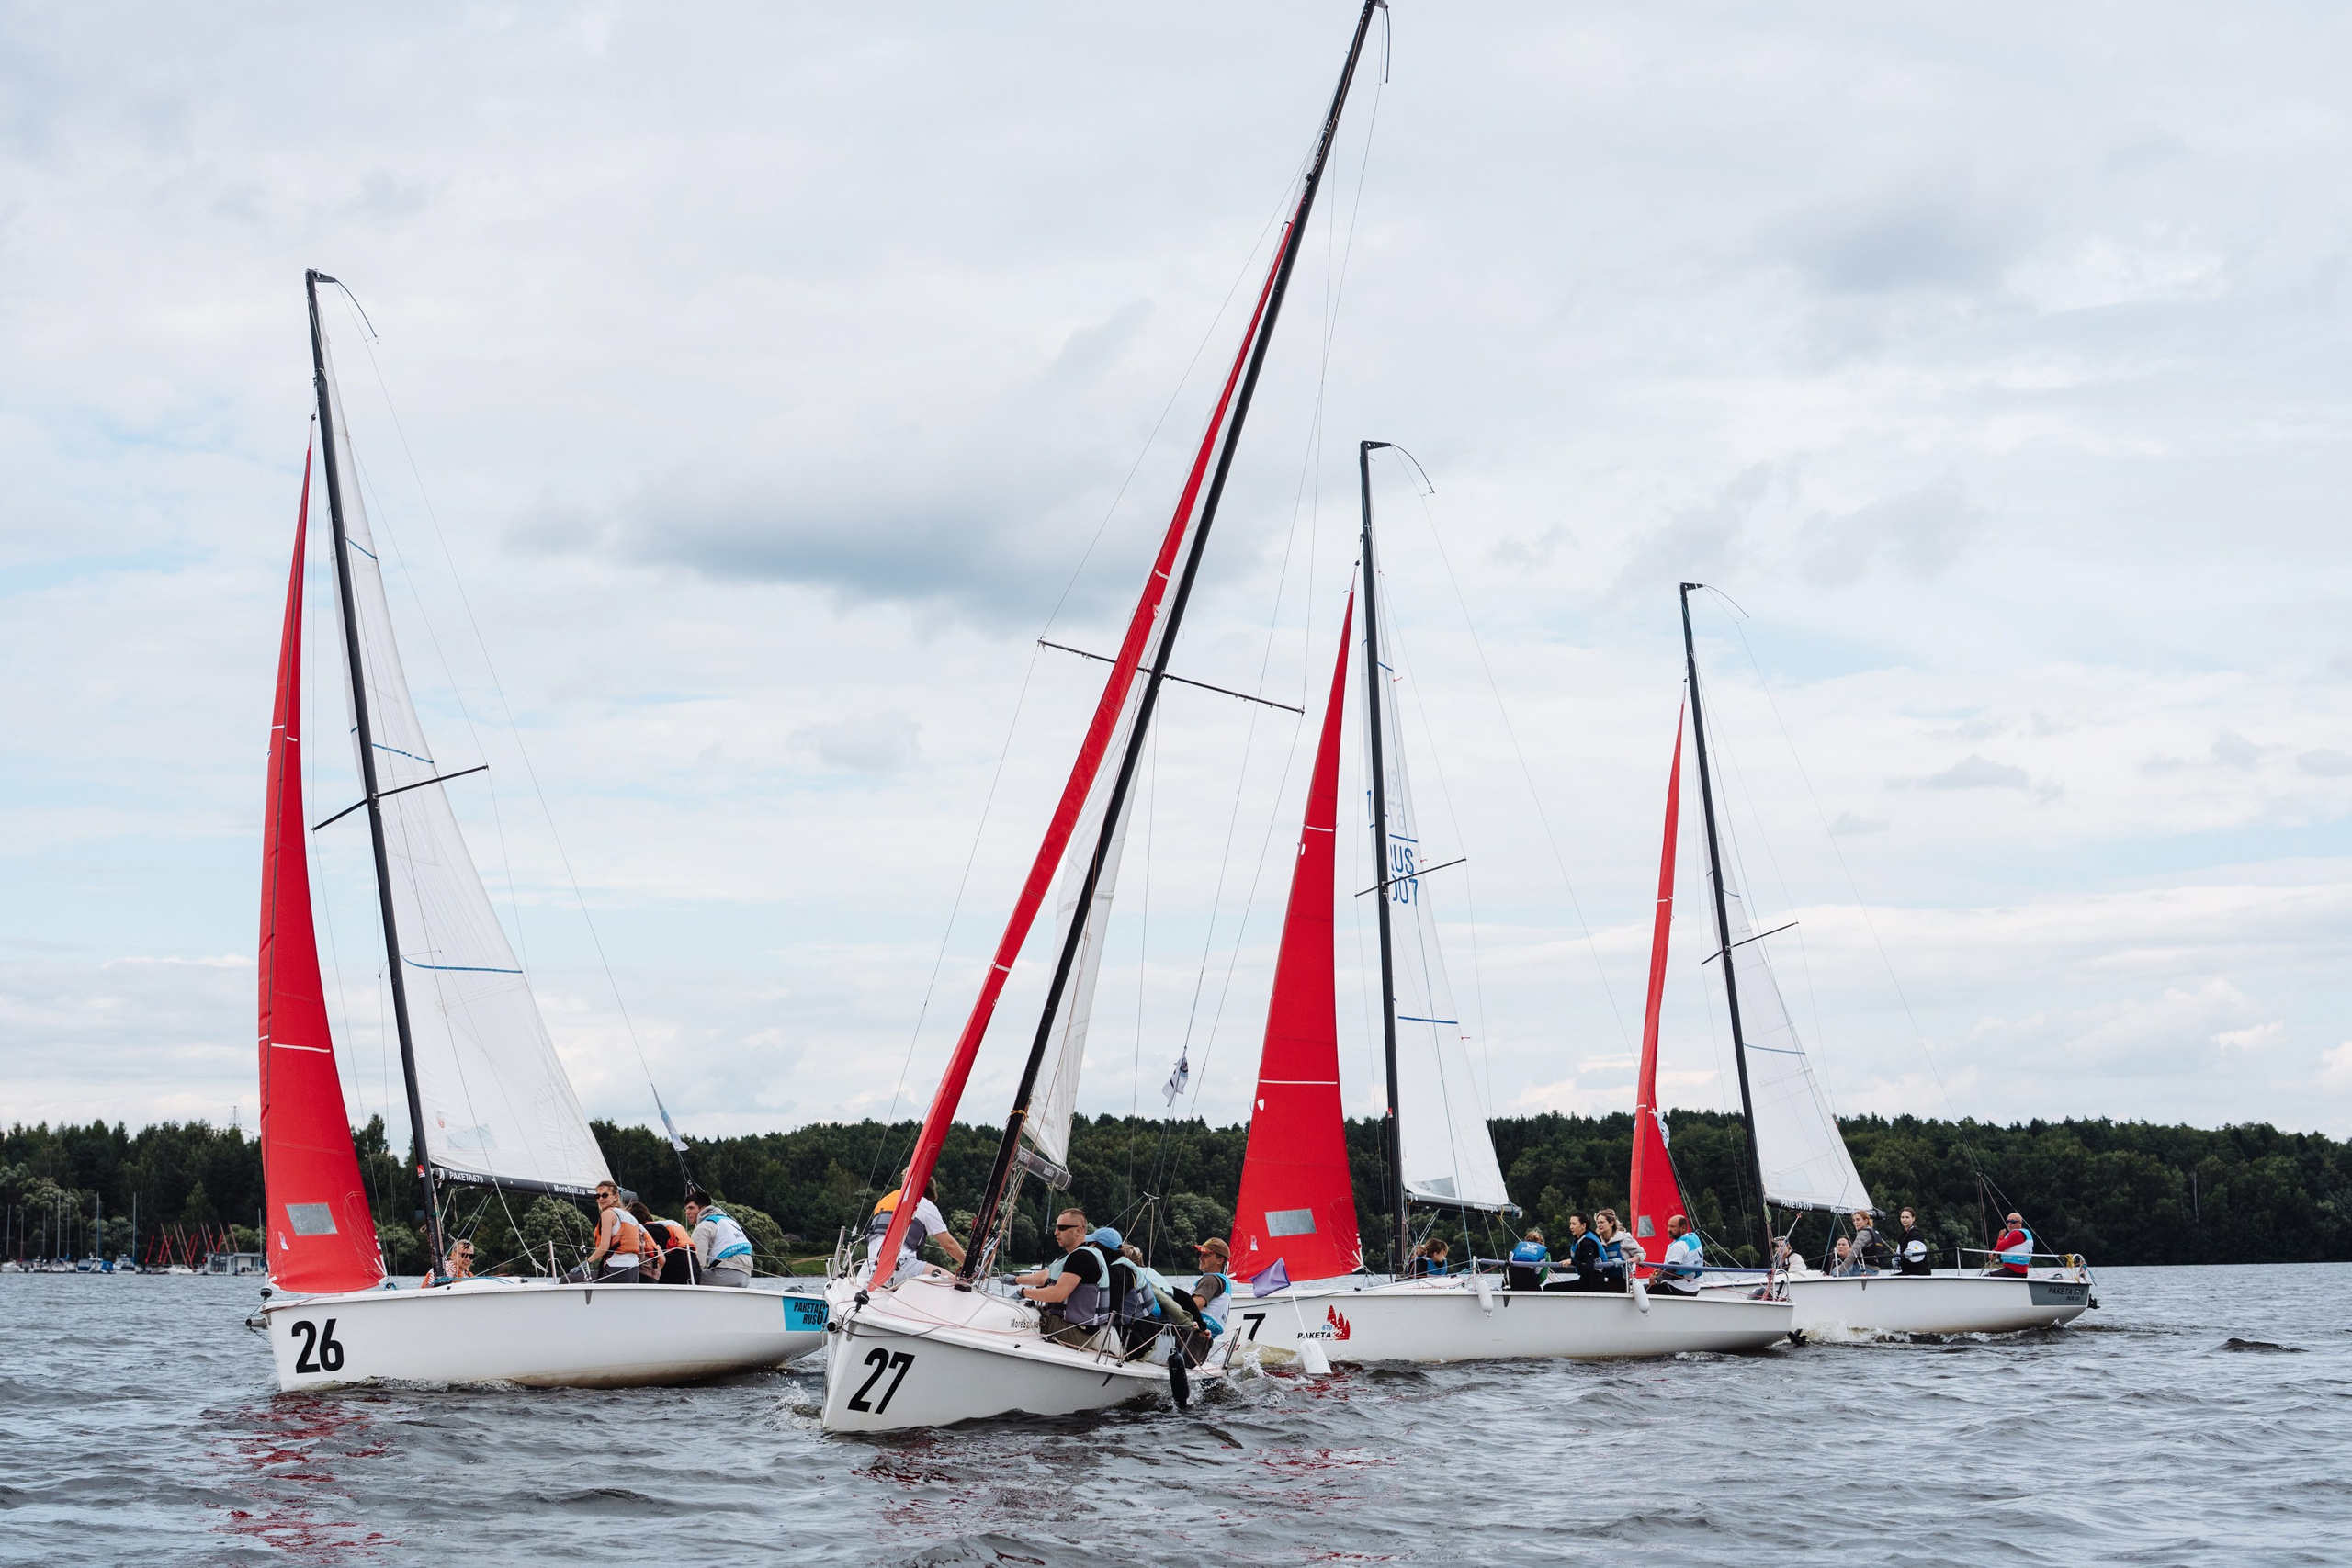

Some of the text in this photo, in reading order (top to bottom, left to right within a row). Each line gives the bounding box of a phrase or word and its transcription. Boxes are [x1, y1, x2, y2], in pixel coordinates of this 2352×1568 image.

[802, 1314, 817, 1325] RUS
[1243, 1313, 1266, 1342] 7
[291, 1318, 345, 1374] 26
[847, 1348, 916, 1415] 27
